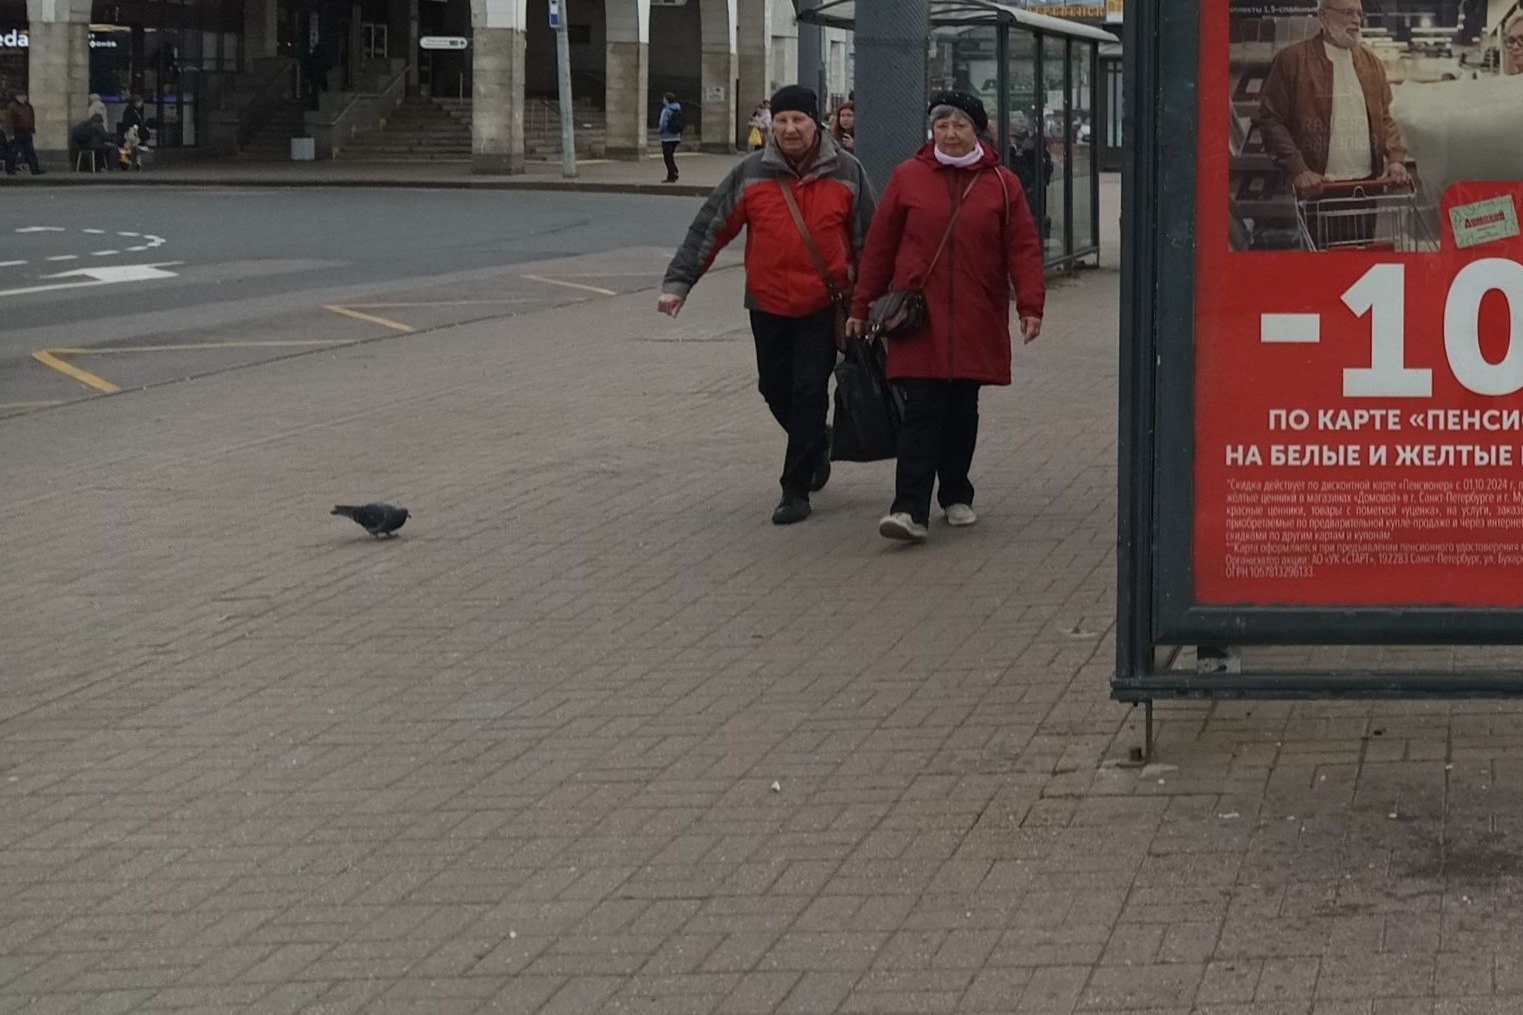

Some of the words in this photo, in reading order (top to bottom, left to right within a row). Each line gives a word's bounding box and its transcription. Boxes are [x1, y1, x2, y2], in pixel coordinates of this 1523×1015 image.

[1268, 409, 1309, 431] ПО
[1318, 409, 1401, 431] КАРТЕ
[1226, 445, 1263, 466] НА
[1270, 445, 1361, 466] БЕЛЫЕ
[1369, 445, 1386, 466] И
[1395, 445, 1514, 466] ЖЕЛТЫЕ
[1307, 494, 1352, 502] магазинах
